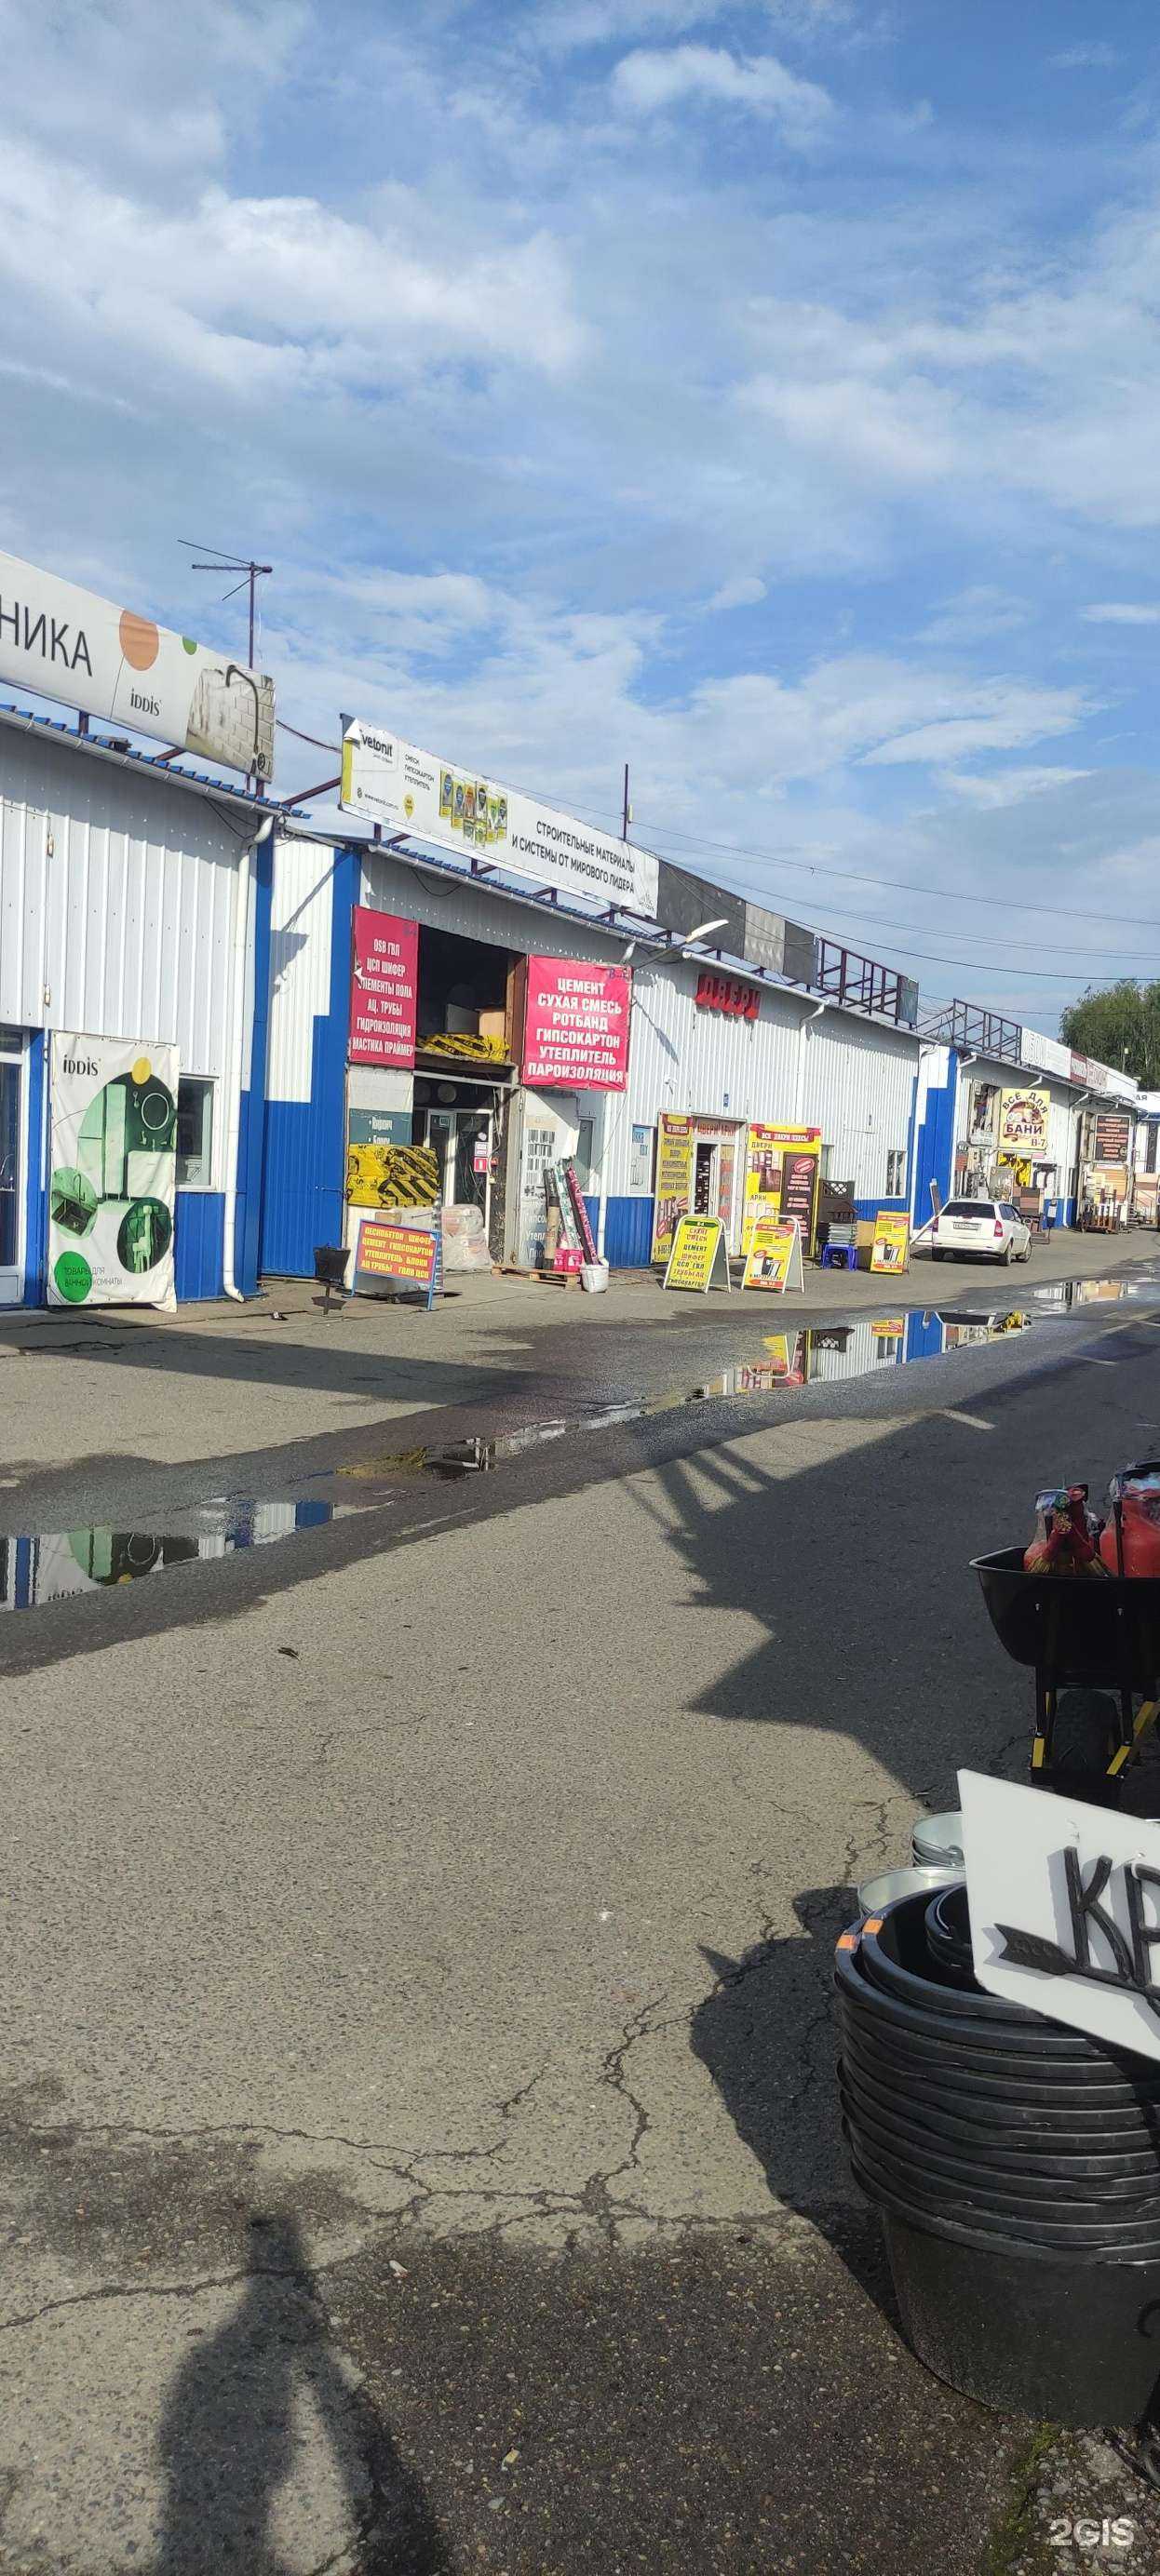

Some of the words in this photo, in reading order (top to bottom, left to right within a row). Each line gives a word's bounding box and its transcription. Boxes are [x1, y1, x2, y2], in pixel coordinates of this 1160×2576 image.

[361, 733, 393, 757] vetonit
[537, 821, 594, 856] СТРОИТЕЛЬНЫЕ
[596, 846, 635, 873] МАТЕРИАЛЫ
[512, 834, 518, 848] И
[519, 839, 557, 865] СИСТЕМЫ
[559, 853, 569, 868] ОТ
[571, 858, 608, 883] МИРОВОГО
[610, 873, 634, 893] ЛИДЕРА
[373, 939, 386, 953] OSB
[387, 942, 400, 957] ГВЛ
[367, 958, 380, 973] ЦСП
[382, 960, 406, 977] ШИФЕР
[396, 983, 412, 999] ПОЛА
[558, 977, 605, 995] ЦЕМЕНТ
[381, 1000, 402, 1016] ТРУБЫ
[538, 993, 578, 1010] СУХАЯ
[582, 998, 622, 1014] СМЕСЬ
[357, 1016, 411, 1039] ГИДРОИЗОЛЯЦИЯ
[552, 1013, 609, 1032] РОТБАНД
[352, 1037, 384, 1053] МАСТИКА
[384, 1040, 413, 1057] ПРАЙМЕР
[536, 1028, 620, 1049] ГИПСОКАРТОН
[539, 1046, 616, 1066] УТЕПЛИТЕЛЬ
[528, 1062, 624, 1082] ПАРОИЗОЛЯЦИЯ
[1029, 1093, 1048, 1114] ДЛЯ
[1006, 1124, 1043, 1135] БАНИ
